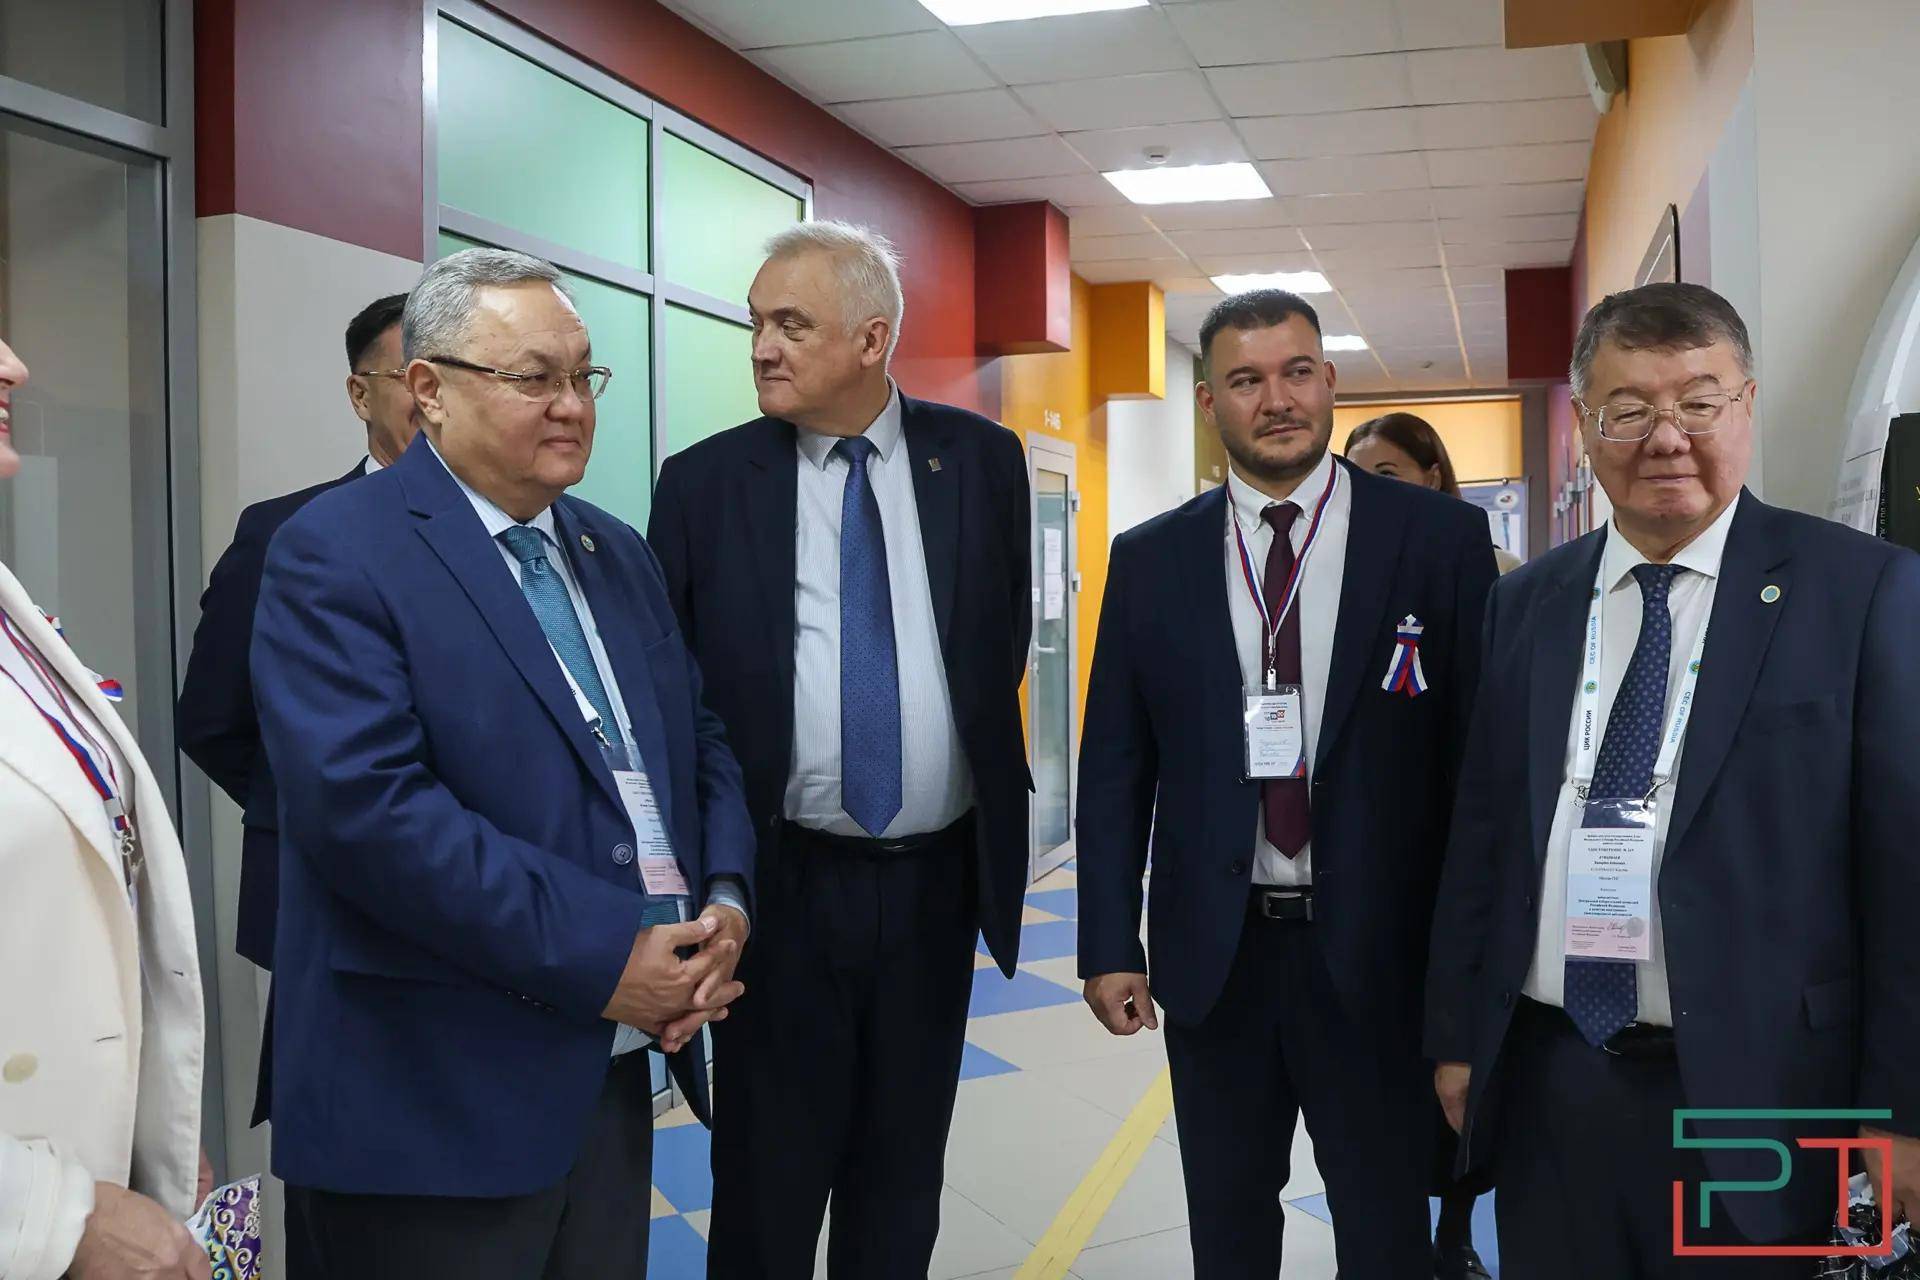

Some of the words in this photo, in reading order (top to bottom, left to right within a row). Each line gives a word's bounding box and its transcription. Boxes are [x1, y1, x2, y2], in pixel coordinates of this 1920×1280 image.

[1590, 642, 1596, 650] OF
[1681, 691, 1691, 705] CEC
[1679, 706, 1686, 716] OF
[1585, 709, 1593, 736] РОССИИ
[1669, 716, 1682, 743] RUSSIA
